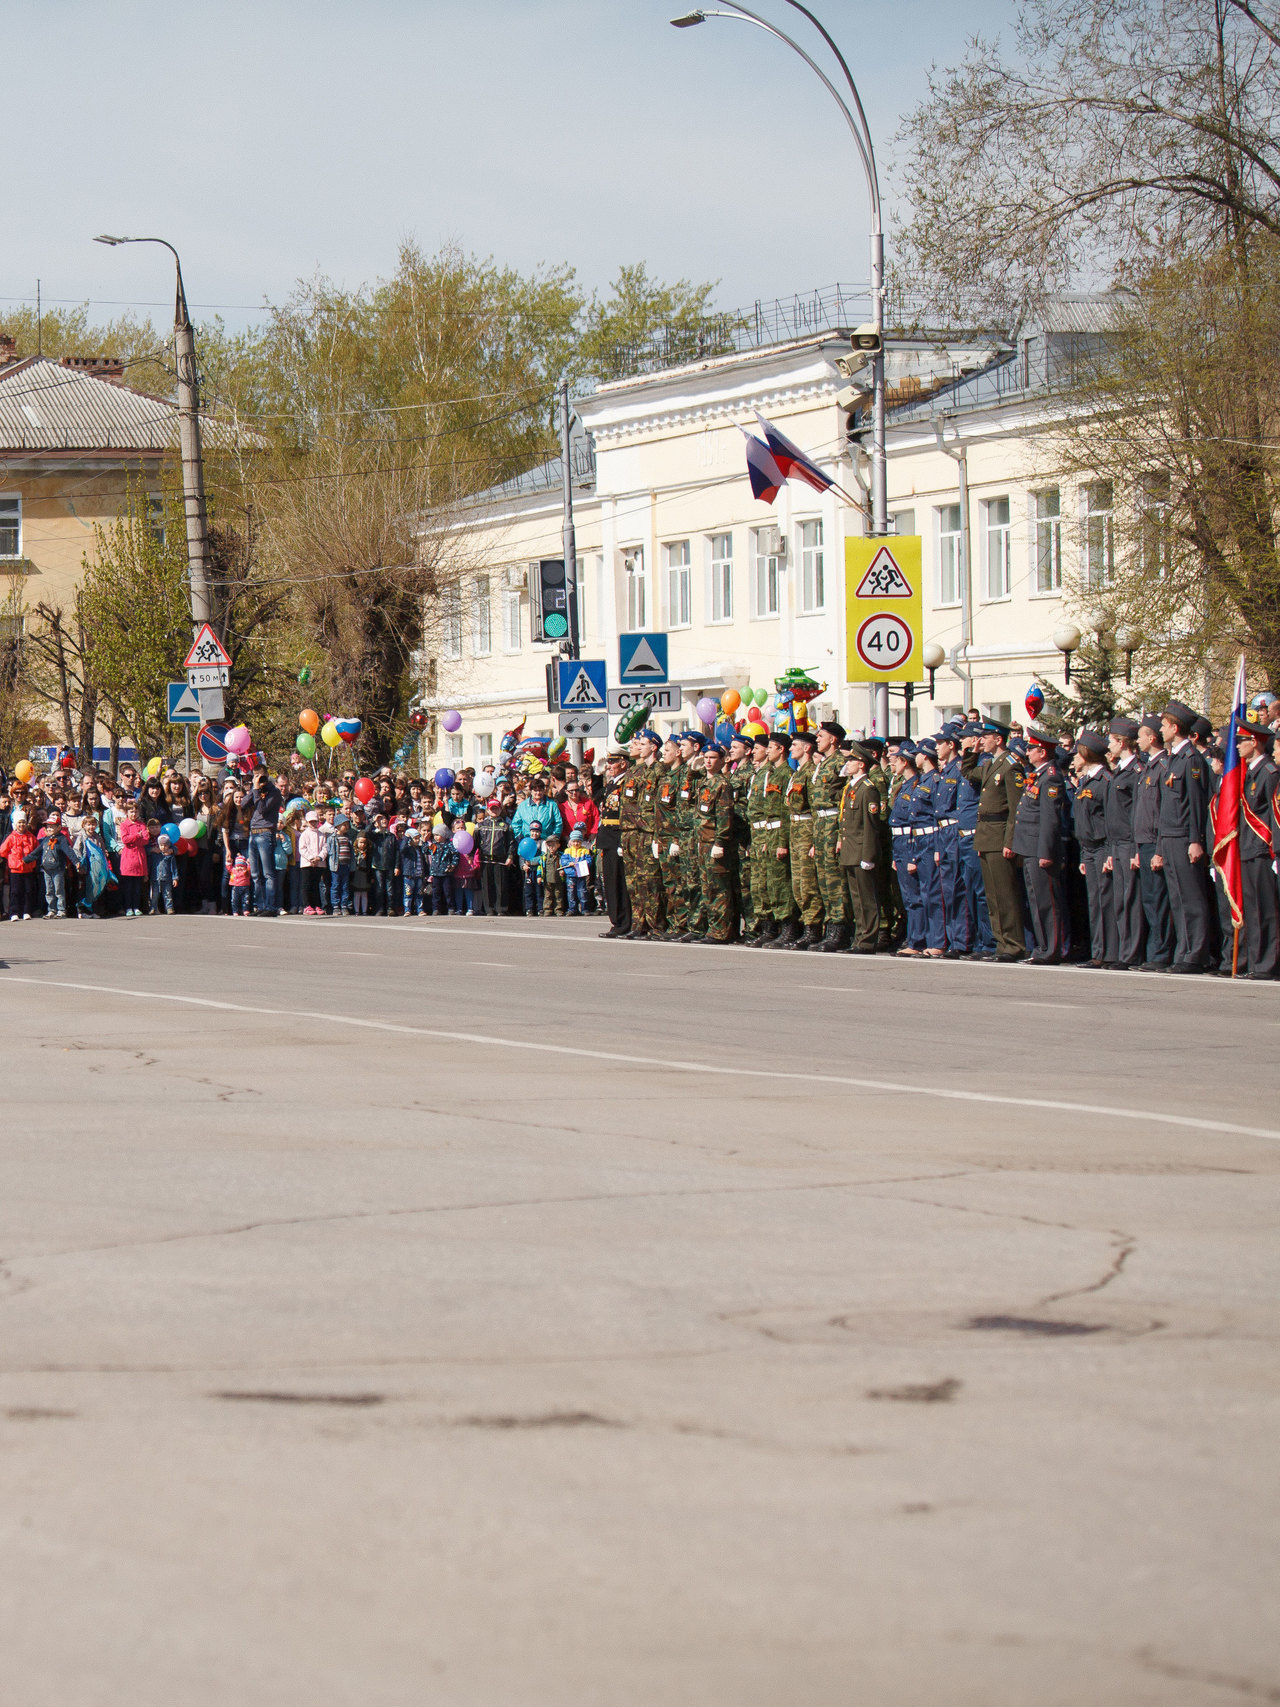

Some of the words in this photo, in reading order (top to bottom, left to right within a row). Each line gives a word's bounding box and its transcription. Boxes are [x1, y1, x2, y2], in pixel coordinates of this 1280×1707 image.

[555, 588, 566, 609] 2
[867, 630, 900, 652] 40
[199, 674, 211, 683] 50
[618, 691, 671, 709] СТОП
